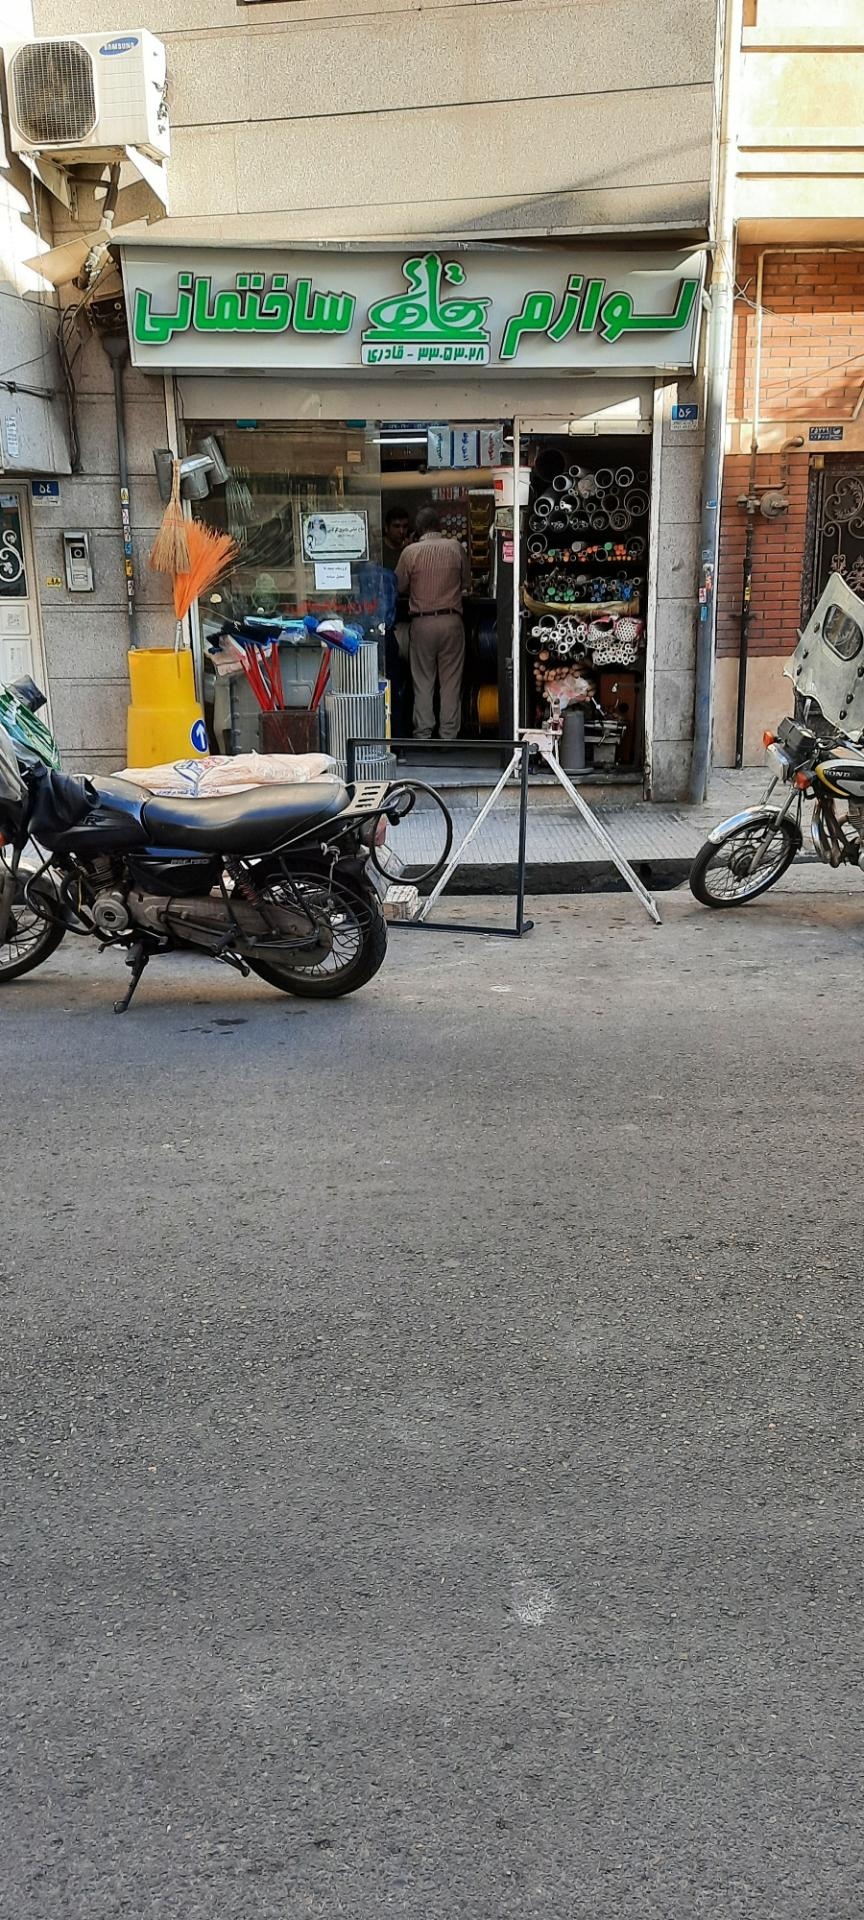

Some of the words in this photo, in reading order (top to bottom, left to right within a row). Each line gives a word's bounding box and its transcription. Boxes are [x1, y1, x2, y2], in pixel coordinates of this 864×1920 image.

[133, 271, 356, 345] ساختمانی
[500, 275, 699, 359] لوازم
[367, 345, 404, 362] قادری
[678, 407, 692, 418] ۵۶
